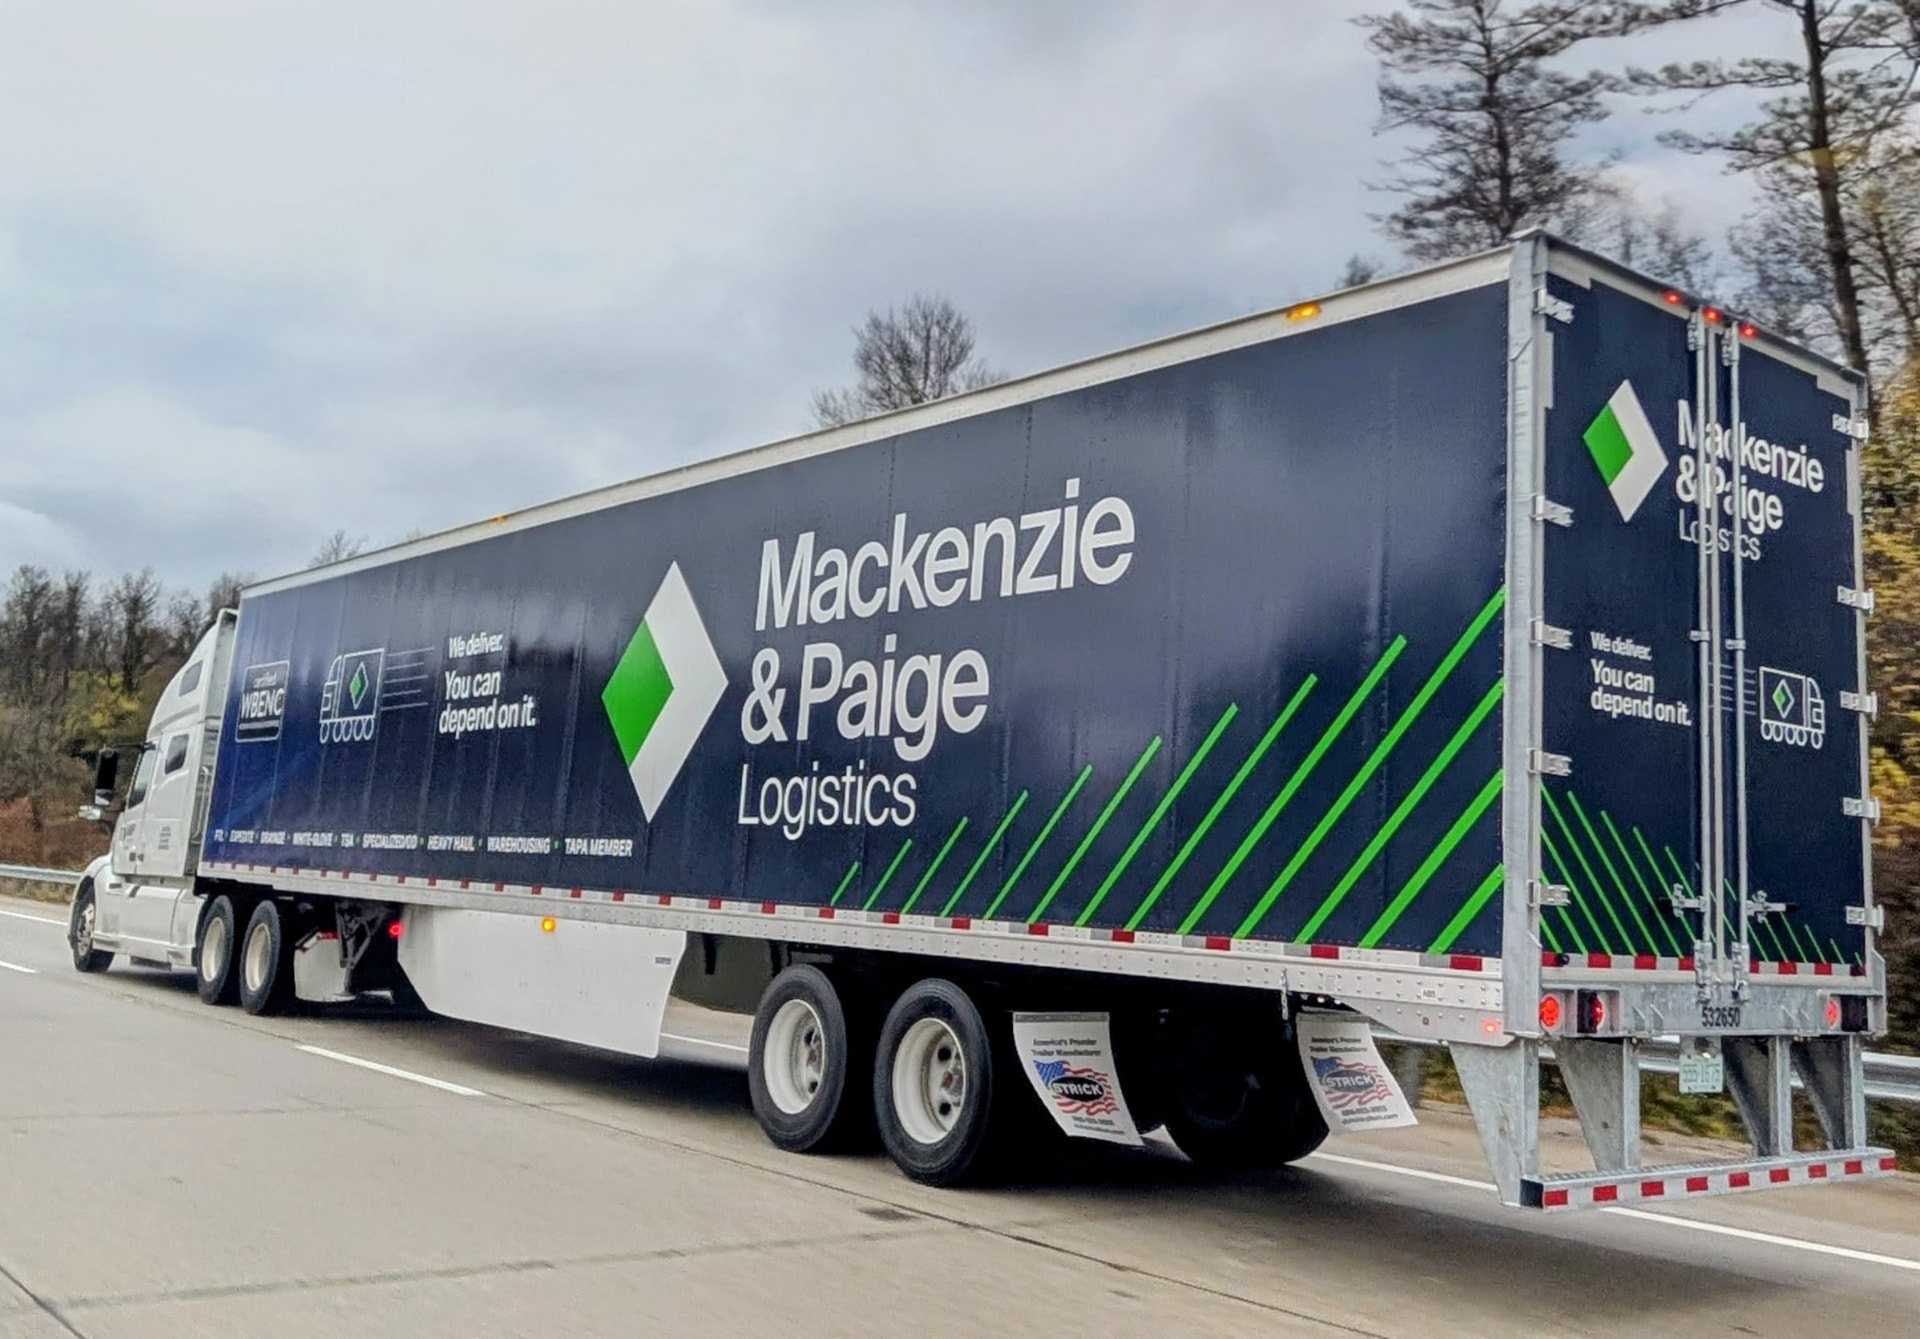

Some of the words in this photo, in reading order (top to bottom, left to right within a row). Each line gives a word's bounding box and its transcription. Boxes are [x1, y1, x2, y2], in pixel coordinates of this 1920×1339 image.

[1675, 454, 1700, 504] &
[755, 477, 1136, 631] Mackenzie
[449, 636, 465, 659] We
[466, 632, 503, 656] deliver.
[1590, 631, 1611, 652] We
[1611, 636, 1652, 661] deliver.
[444, 670, 471, 700] You
[472, 671, 500, 697] can
[1590, 658, 1622, 687] You
[1624, 671, 1654, 694] can
[241, 687, 285, 719] WBENC
[741, 647, 788, 744] &
[797, 633, 990, 762] Paige
[1590, 686, 1653, 719] depend
[1654, 702, 1675, 723] on
[1676, 701, 1692, 726] it.
[439, 698, 497, 740] depend
[498, 703, 519, 729] on
[520, 694, 536, 727] it.
[738, 759, 917, 840] Logistics
[427, 835, 454, 850] HEAVY
[453, 836, 475, 852] HAUL
[487, 836, 551, 854] WAREHOUSING
[565, 838, 589, 855] TAPA
[589, 839, 633, 857] MEMBER
[1701, 1006, 1740, 1027] 532650
[1051, 1082, 1103, 1096] STRICK
[1326, 1074, 1374, 1088] STRICK
